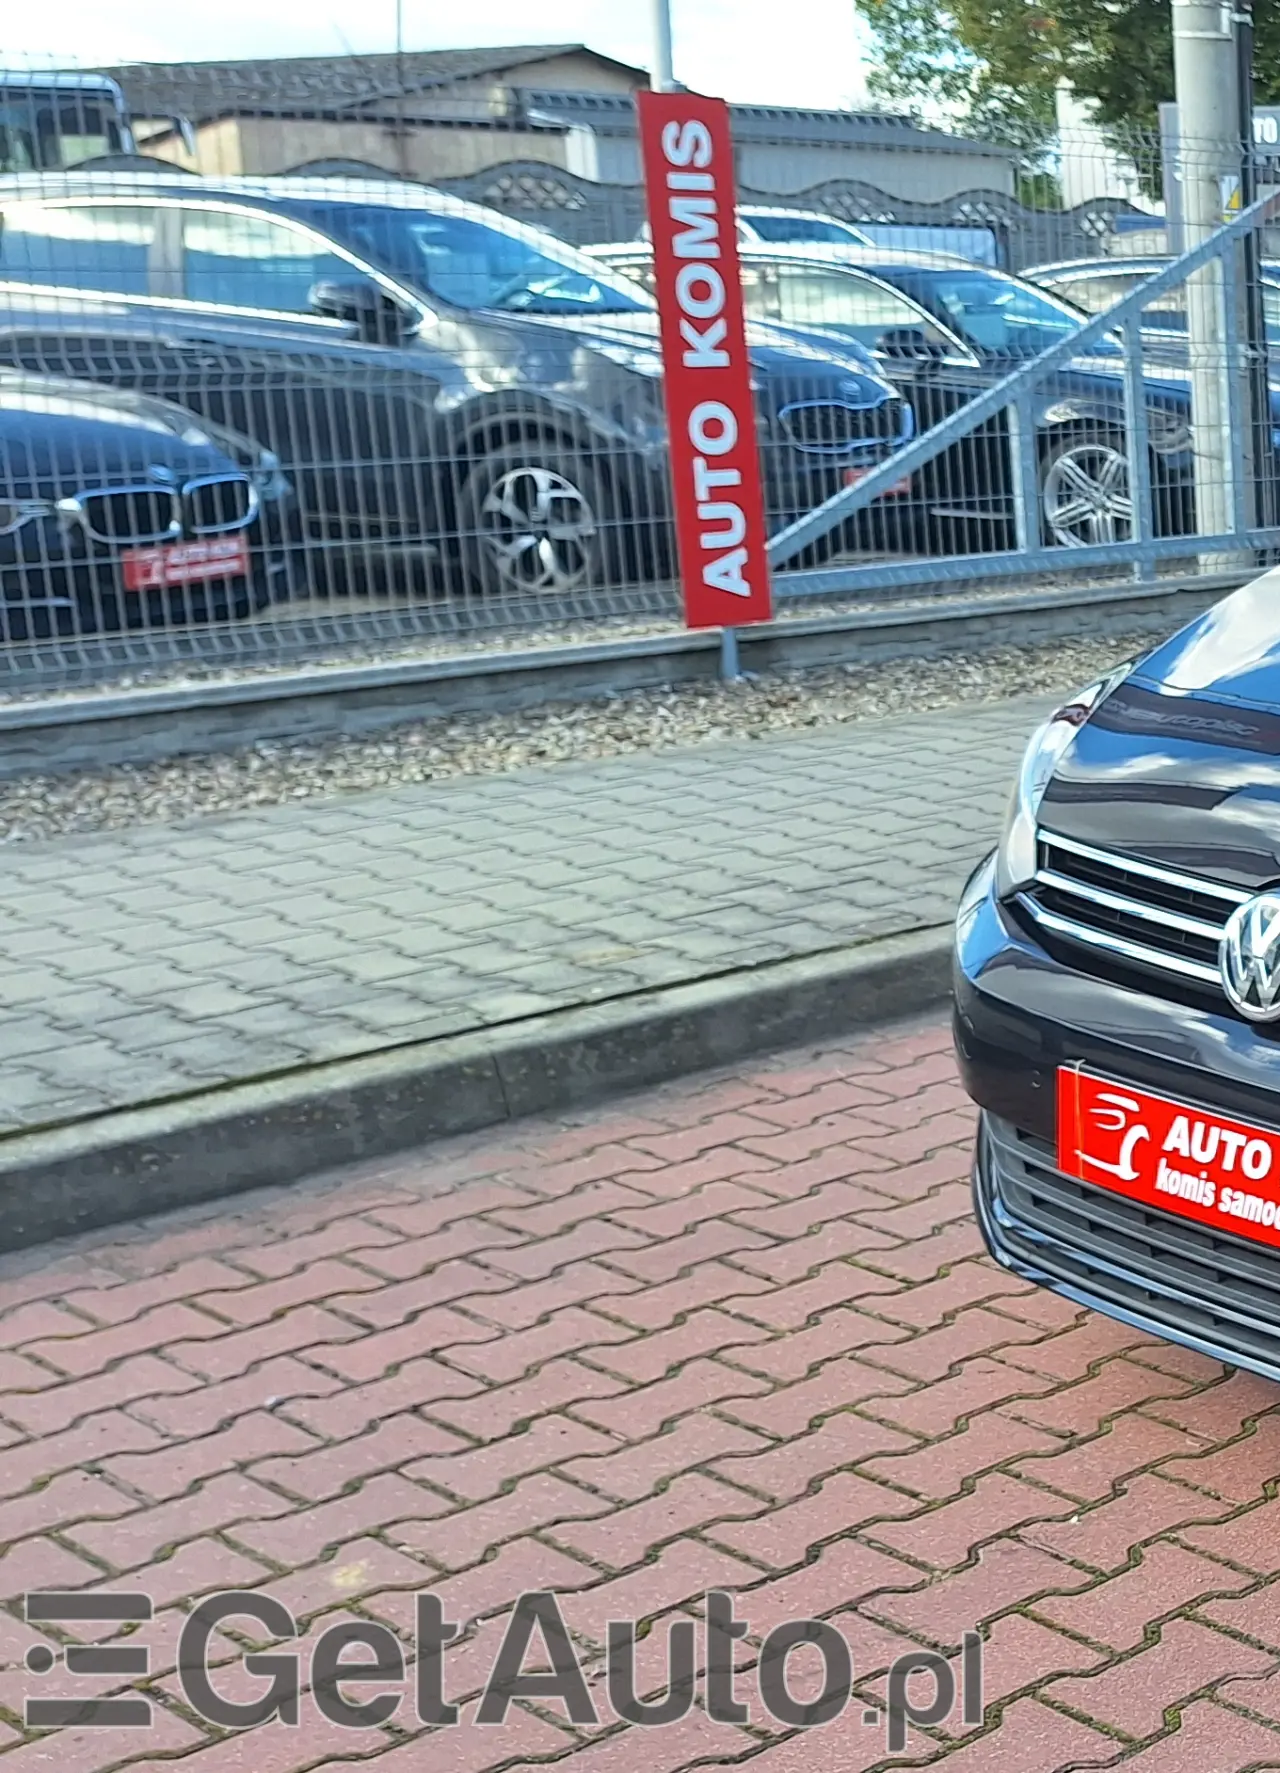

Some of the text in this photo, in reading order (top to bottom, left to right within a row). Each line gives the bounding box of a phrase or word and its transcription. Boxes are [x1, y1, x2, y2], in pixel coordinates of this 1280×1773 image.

[661, 119, 752, 599] AUTO KOMIS
[1161, 1115, 1273, 1181] AUTO
[1155, 1157, 1216, 1208] komis
